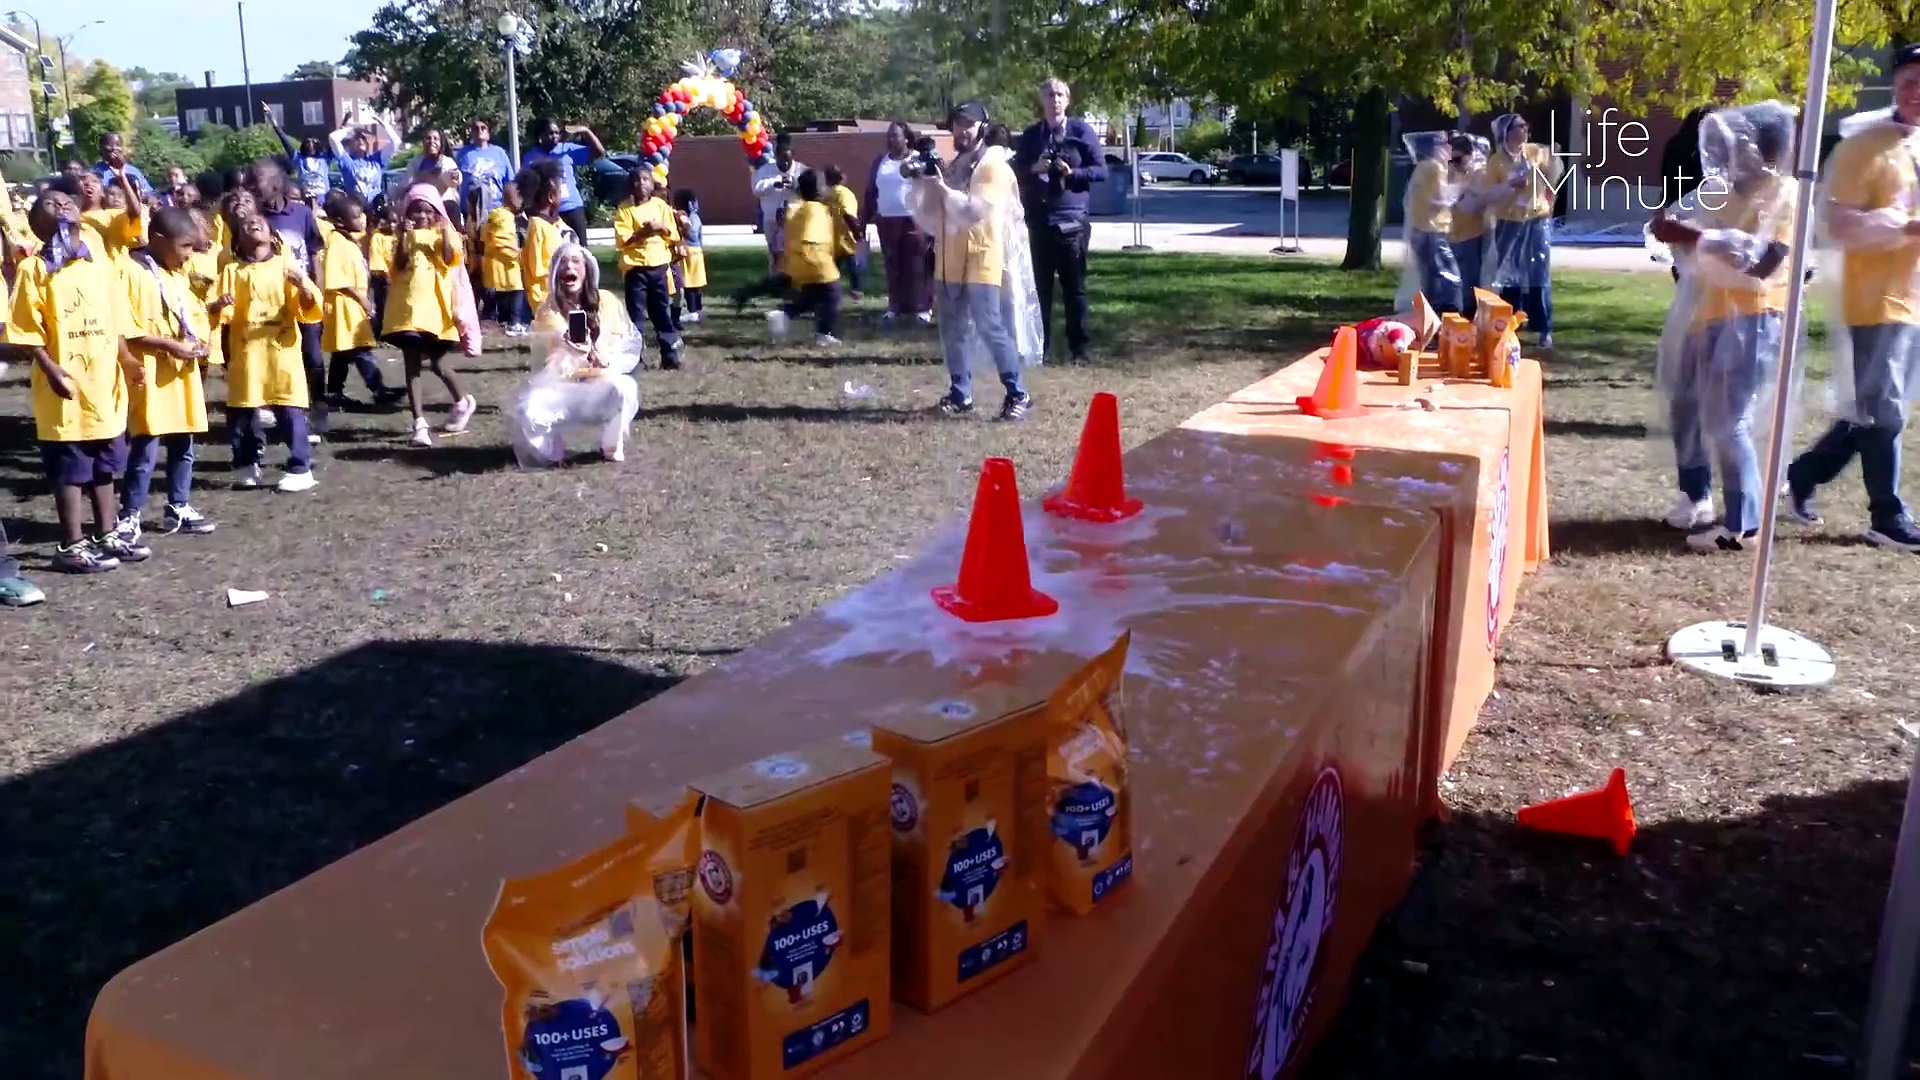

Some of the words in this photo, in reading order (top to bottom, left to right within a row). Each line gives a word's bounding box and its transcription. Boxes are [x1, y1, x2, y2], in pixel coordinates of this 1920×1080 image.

[1091, 796, 1111, 812] USES
[953, 856, 975, 873] 100+
[976, 847, 997, 864] USES
[773, 933, 801, 950] 100+
[802, 920, 830, 940] USES
[534, 1031, 570, 1046] 100+
[571, 1023, 609, 1040] USES
